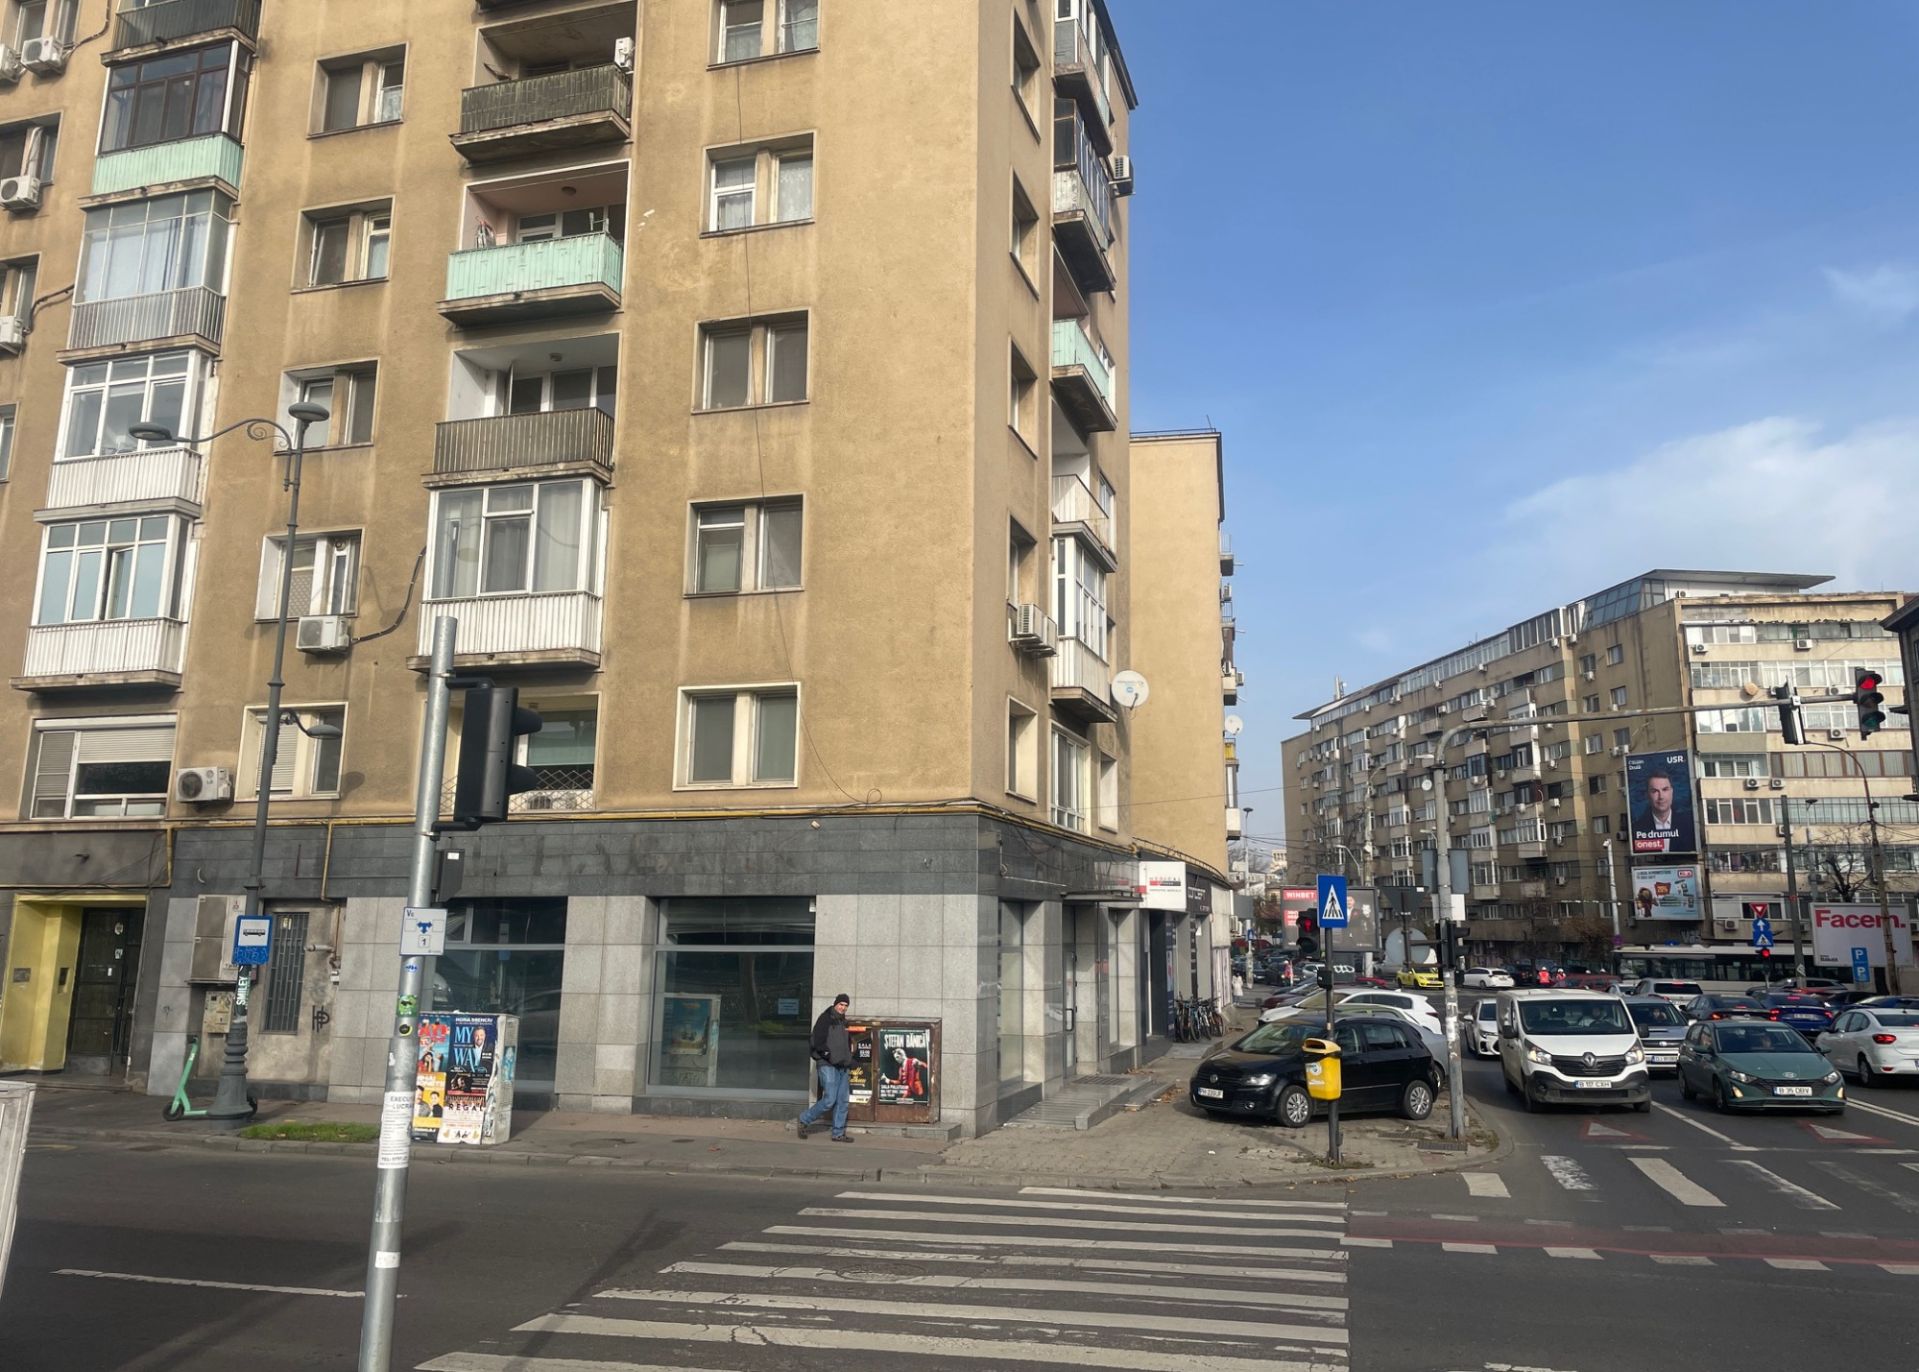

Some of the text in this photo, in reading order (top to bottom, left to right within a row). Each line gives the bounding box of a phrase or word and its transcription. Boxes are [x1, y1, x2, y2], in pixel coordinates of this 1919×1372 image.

[1666, 755, 1684, 764] USR
[1636, 829, 1679, 839] Pe drumul
[1637, 840, 1663, 849] onest.
[1855, 949, 1864, 960] P
[1857, 966, 1866, 977] P
[236, 975, 248, 1006] SMILEY
[454, 1026, 475, 1044] MY
[453, 1048, 482, 1073] WAY
[448, 1103, 484, 1111] REGAL
